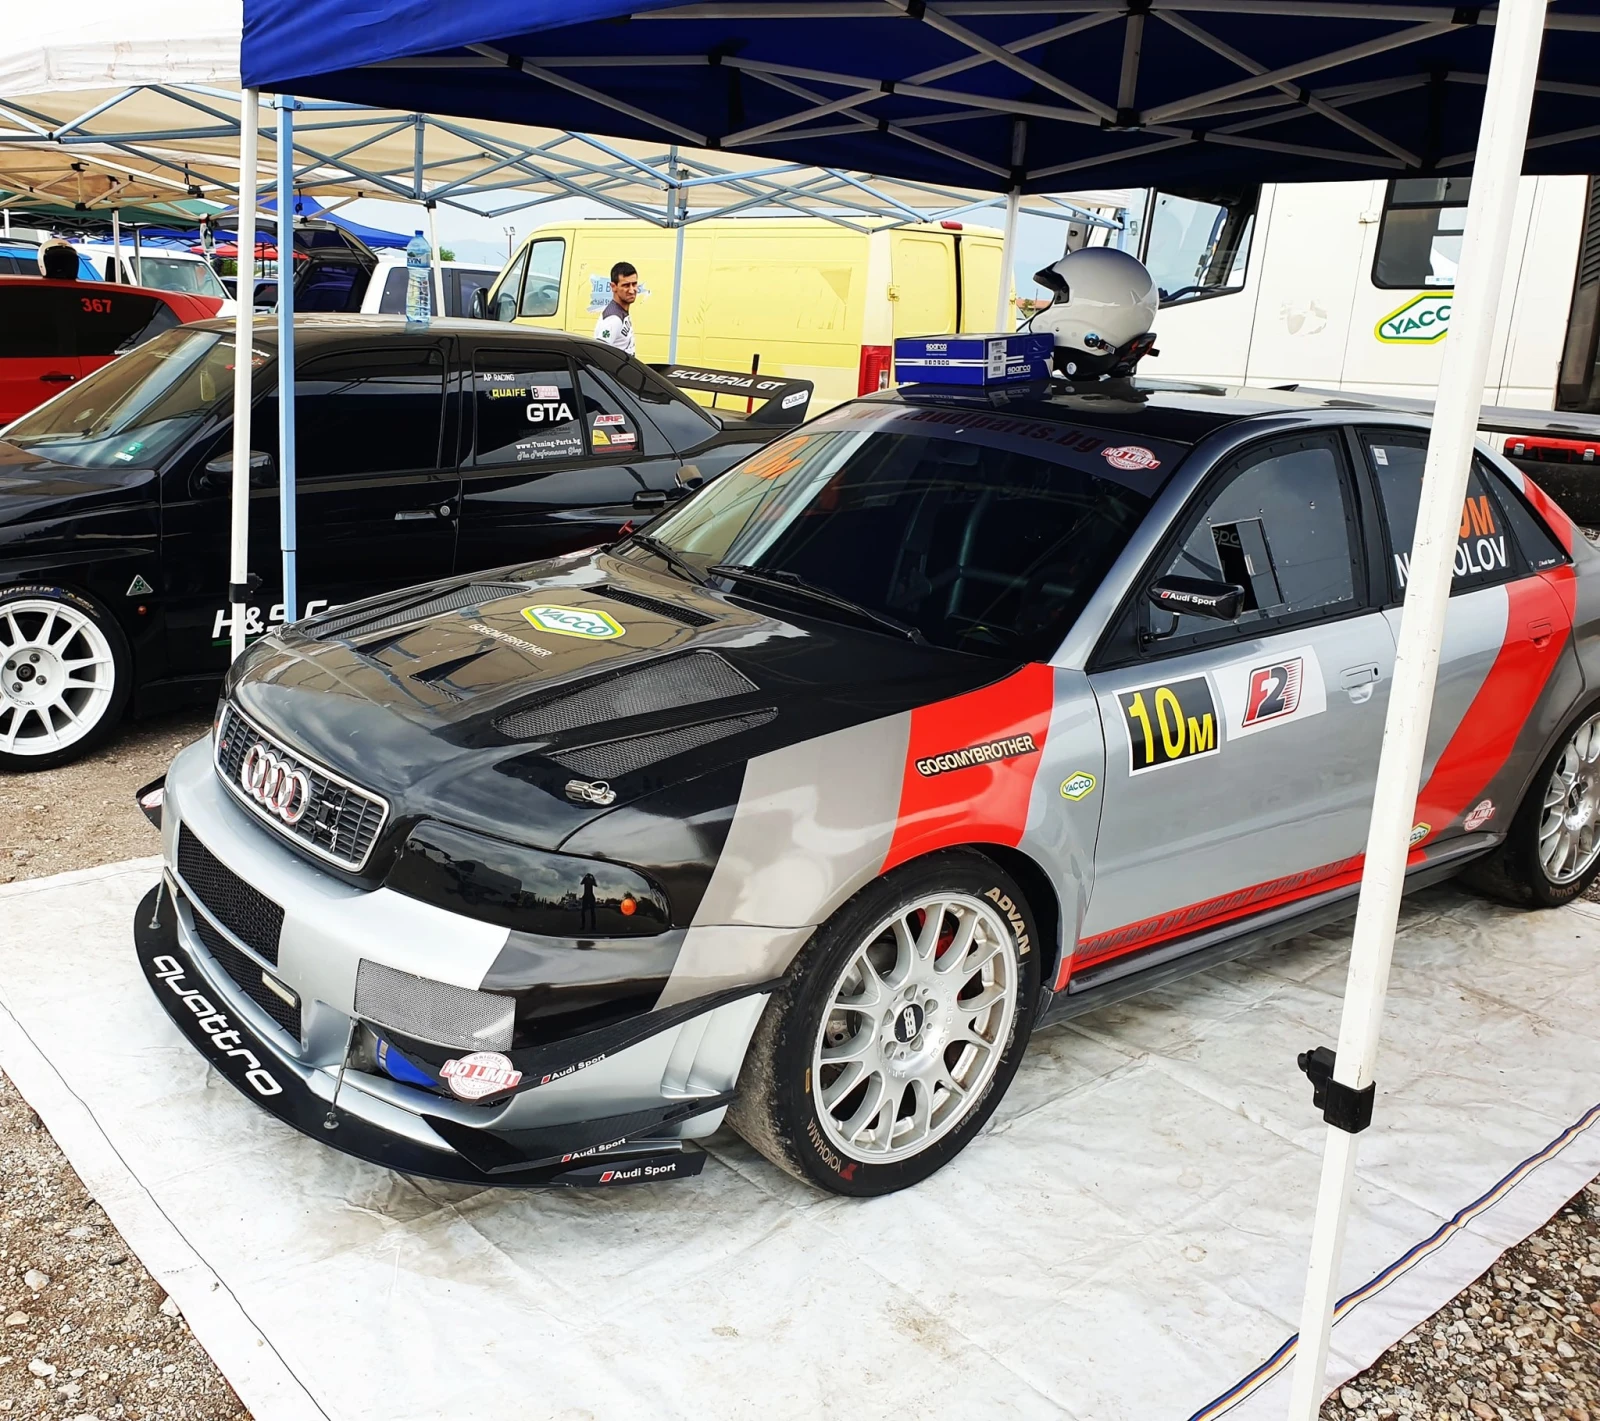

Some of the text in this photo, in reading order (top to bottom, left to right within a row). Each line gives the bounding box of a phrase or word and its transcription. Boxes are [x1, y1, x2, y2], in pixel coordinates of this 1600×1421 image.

[81, 298, 112, 313] 367
[1388, 305, 1451, 335] YACC
[926, 343, 948, 352] sparco
[483, 373, 515, 382] AP RACING
[667, 369, 787, 391] SCUDERIA GT
[1007, 364, 1031, 375] sparco
[492, 388, 526, 398] QUAIFE
[526, 403, 574, 422] GTA
[597, 415, 623, 423] ARP
[516, 438, 581, 450] www.Tuning-Parts.bg
[1102, 447, 1123, 458] NO
[1124, 452, 1161, 469] LIMIT
[1394, 536, 1509, 588] NOLOV
[0, 586, 55, 597] ICHELIN
[1169, 592, 1217, 606] Audi Sport
[538, 608, 609, 635] YACCO
[1246, 666, 1289, 722] F2
[1128, 687, 1214, 764] 10M
[917, 734, 1035, 776] GOGOMYBROTHER
[1064, 779, 1091, 793] YACCO
[984, 887, 1031, 956] ADVAN
[153, 955, 283, 1096] quattro
[903, 1006, 917, 1039] BBS
[444, 1060, 519, 1086] NO LIMIT
[551, 1053, 606, 1080] Audi Sport
[572, 1137, 626, 1160] Audi Sport
[806, 1116, 842, 1174] YOKOHAMA
[613, 1162, 676, 1180] Audi Sport
